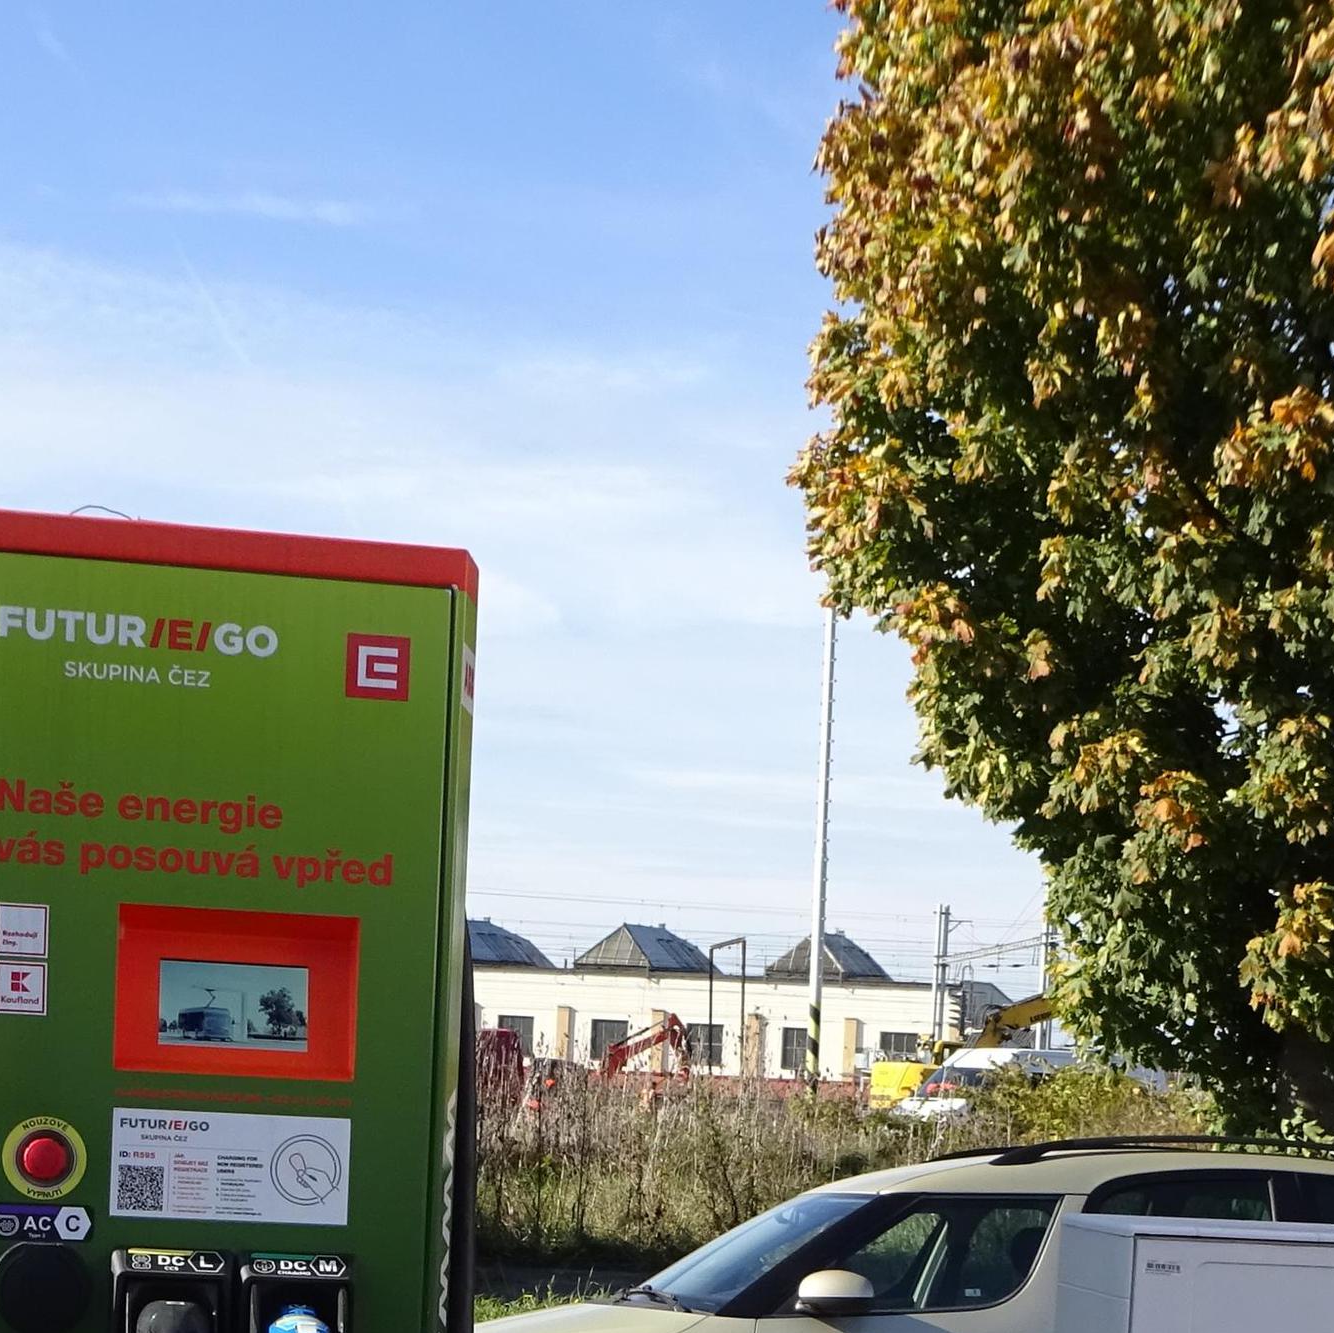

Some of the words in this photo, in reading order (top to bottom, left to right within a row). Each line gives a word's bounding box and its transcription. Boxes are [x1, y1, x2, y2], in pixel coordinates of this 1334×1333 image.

[64, 661, 161, 684] SKUPINA
[168, 664, 211, 687] ČEZ
[118, 793, 284, 834] energie
[80, 844, 261, 876] posouvá
[273, 847, 395, 888] vpřed
[0, 995, 40, 1005] Kaufland
[120, 1117, 210, 1131] FUTUR/E/GO
[23, 1215, 52, 1231] AC
[65, 1215, 81, 1232] C
[157, 1255, 185, 1266] DC
[199, 1255, 214, 1268] L
[280, 1260, 307, 1271] DC
[319, 1259, 338, 1273] M
